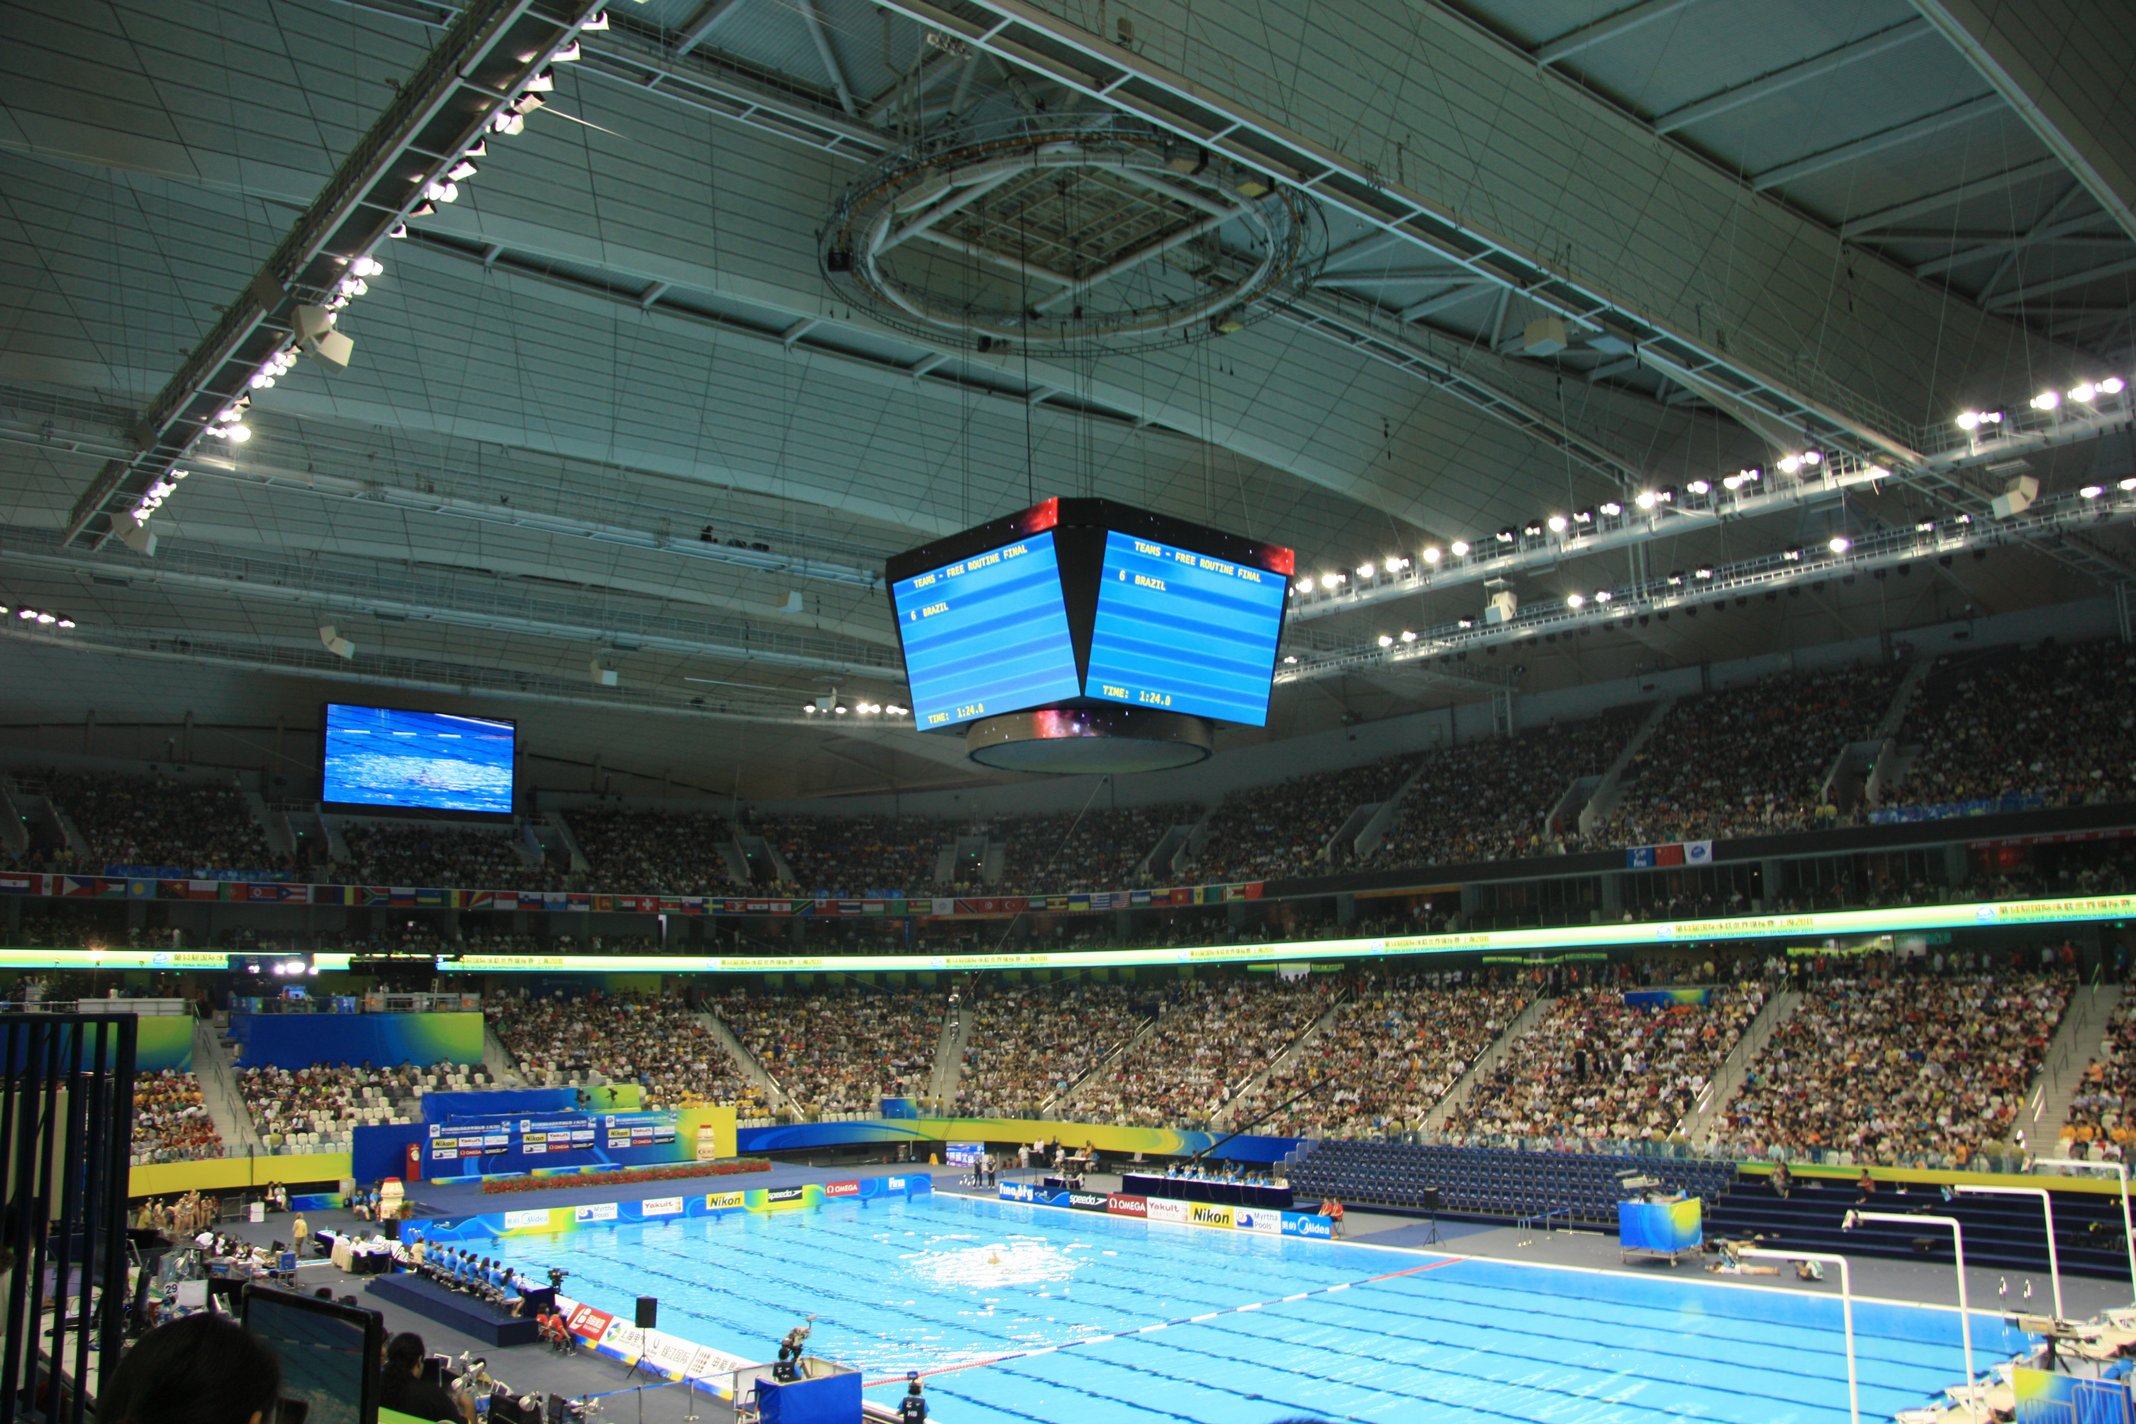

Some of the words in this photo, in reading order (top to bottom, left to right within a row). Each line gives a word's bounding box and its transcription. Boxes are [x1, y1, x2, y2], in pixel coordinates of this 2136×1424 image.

[913, 574, 936, 589] TEAMS
[946, 564, 966, 578] FREE
[968, 553, 1000, 571] ROUTINE
[1003, 544, 1028, 560] FINAL
[1135, 541, 1161, 556] TEAMS
[1175, 552, 1196, 566] FREE
[1200, 558, 1234, 576] ROUTINE
[1238, 567, 1261, 583] FINAL
[1119, 570, 1126, 581] 6
[1135, 575, 1166, 591] BRAZIL
[911, 611, 916, 620] 6
[923, 602, 949, 618] BRAZIL
[1103, 685, 1129, 699] TIME:
[1139, 690, 1171, 706] 1:24.0
[928, 712, 949, 724] TIME:
[957, 703, 985, 719] 1:24.0
[834, 1184, 858, 1193] OMEGA
[644, 1201, 674, 1209] Yakult
[710, 1196, 741, 1207] Nikon
[1069, 1193, 1096, 1206] speedo
[1119, 1200, 1145, 1212] OMEGA
[1149, 1202, 1179, 1212] Yakult
[1193, 1207, 1229, 1224] Nikon
[1254, 1212, 1278, 1221] Myrtha
[1255, 1221, 1272, 1230] Pools
[1298, 1217, 1330, 1235] Midea
[165, 1284, 177, 1294] 29
